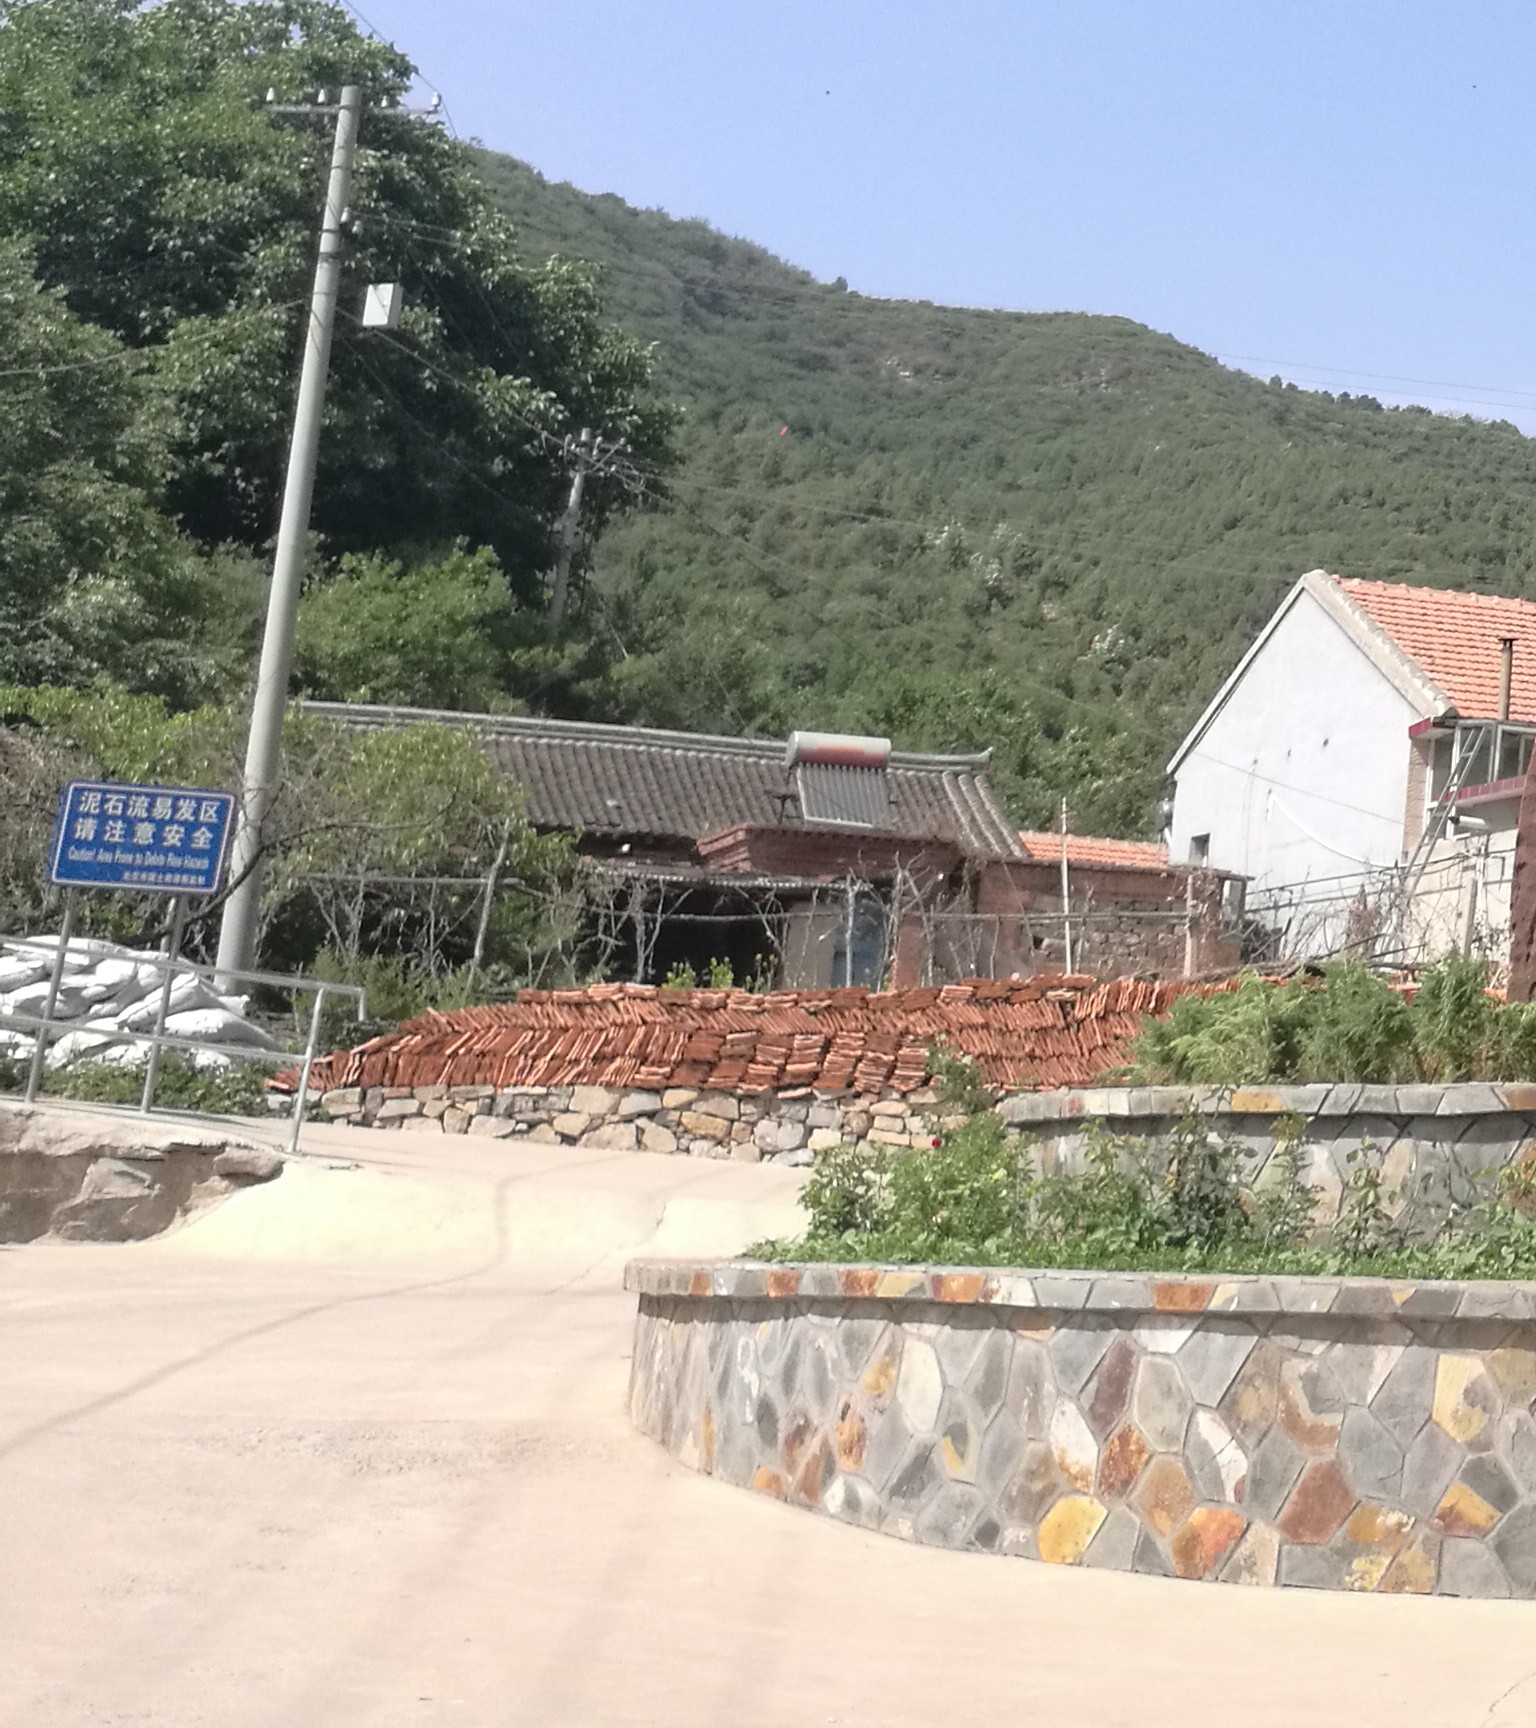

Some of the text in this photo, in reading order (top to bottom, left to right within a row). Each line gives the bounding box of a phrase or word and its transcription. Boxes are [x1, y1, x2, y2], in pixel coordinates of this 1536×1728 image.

[79, 791, 221, 823] 泥石流易发区
[74, 817, 213, 849] 请注意安全
